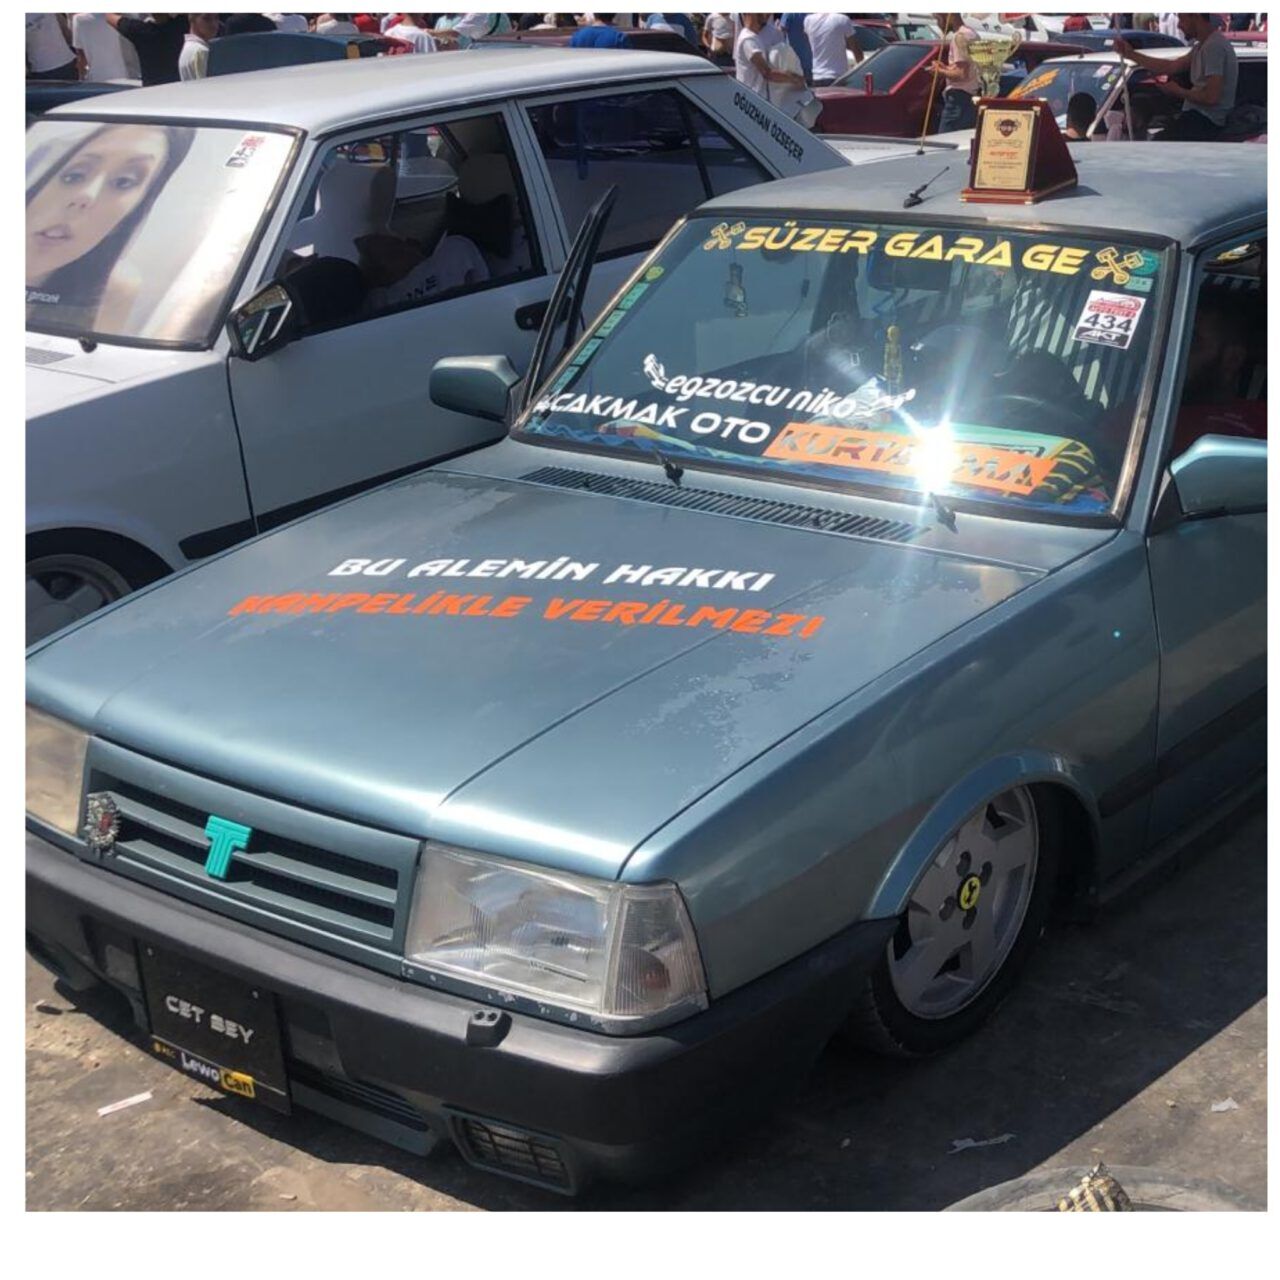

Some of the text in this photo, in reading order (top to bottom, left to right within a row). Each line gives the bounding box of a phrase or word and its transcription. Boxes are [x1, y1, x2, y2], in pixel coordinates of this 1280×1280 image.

[736, 221, 878, 254] SÜZER
[1084, 313, 1132, 333] 434
[665, 374, 857, 418] egzozcu niko
[690, 412, 771, 443] OTO
[777, 430, 1034, 487] KURTAMA
[328, 556, 776, 592] BU ALEMİN HAKKI
[166, 995, 254, 1044] CET BEY
[181, 1052, 219, 1082] Lewo
